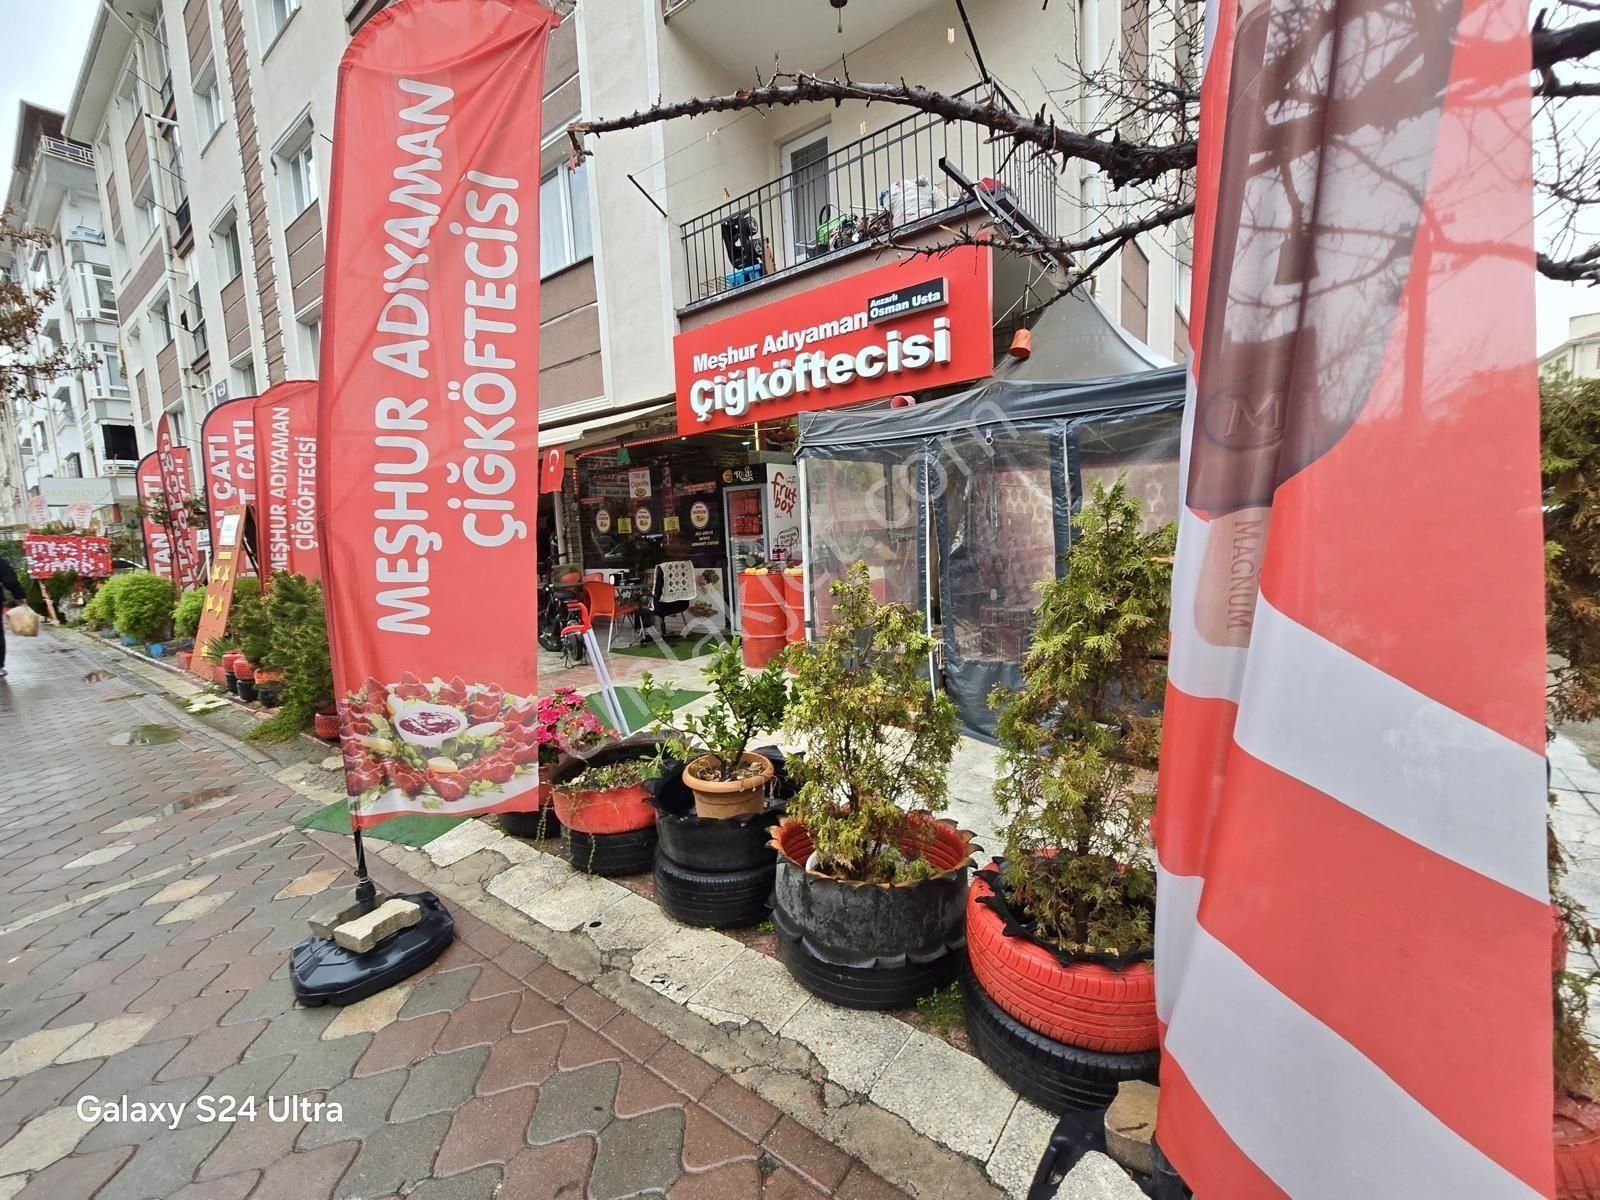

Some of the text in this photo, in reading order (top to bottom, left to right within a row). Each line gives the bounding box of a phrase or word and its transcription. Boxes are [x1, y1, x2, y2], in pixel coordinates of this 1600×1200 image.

[693, 310, 869, 374] Meşhur Adıyaman
[870, 290, 941, 319] Osman Usta
[372, 77, 455, 636] MEŞHUR ADIYAMAN
[446, 169, 527, 547] ÇİĞKÖFTECİSİ
[690, 317, 951, 422] Çiğköftecisi
[208, 435, 237, 500] ÇATI
[269, 407, 290, 499] ADIYAMAN
[291, 436, 319, 550] ÇİĞKÖFTECİSİ
[774, 490, 794, 519] box
[143, 532, 172, 576] TAN
[1226, 518, 1262, 631] MAGNUM
